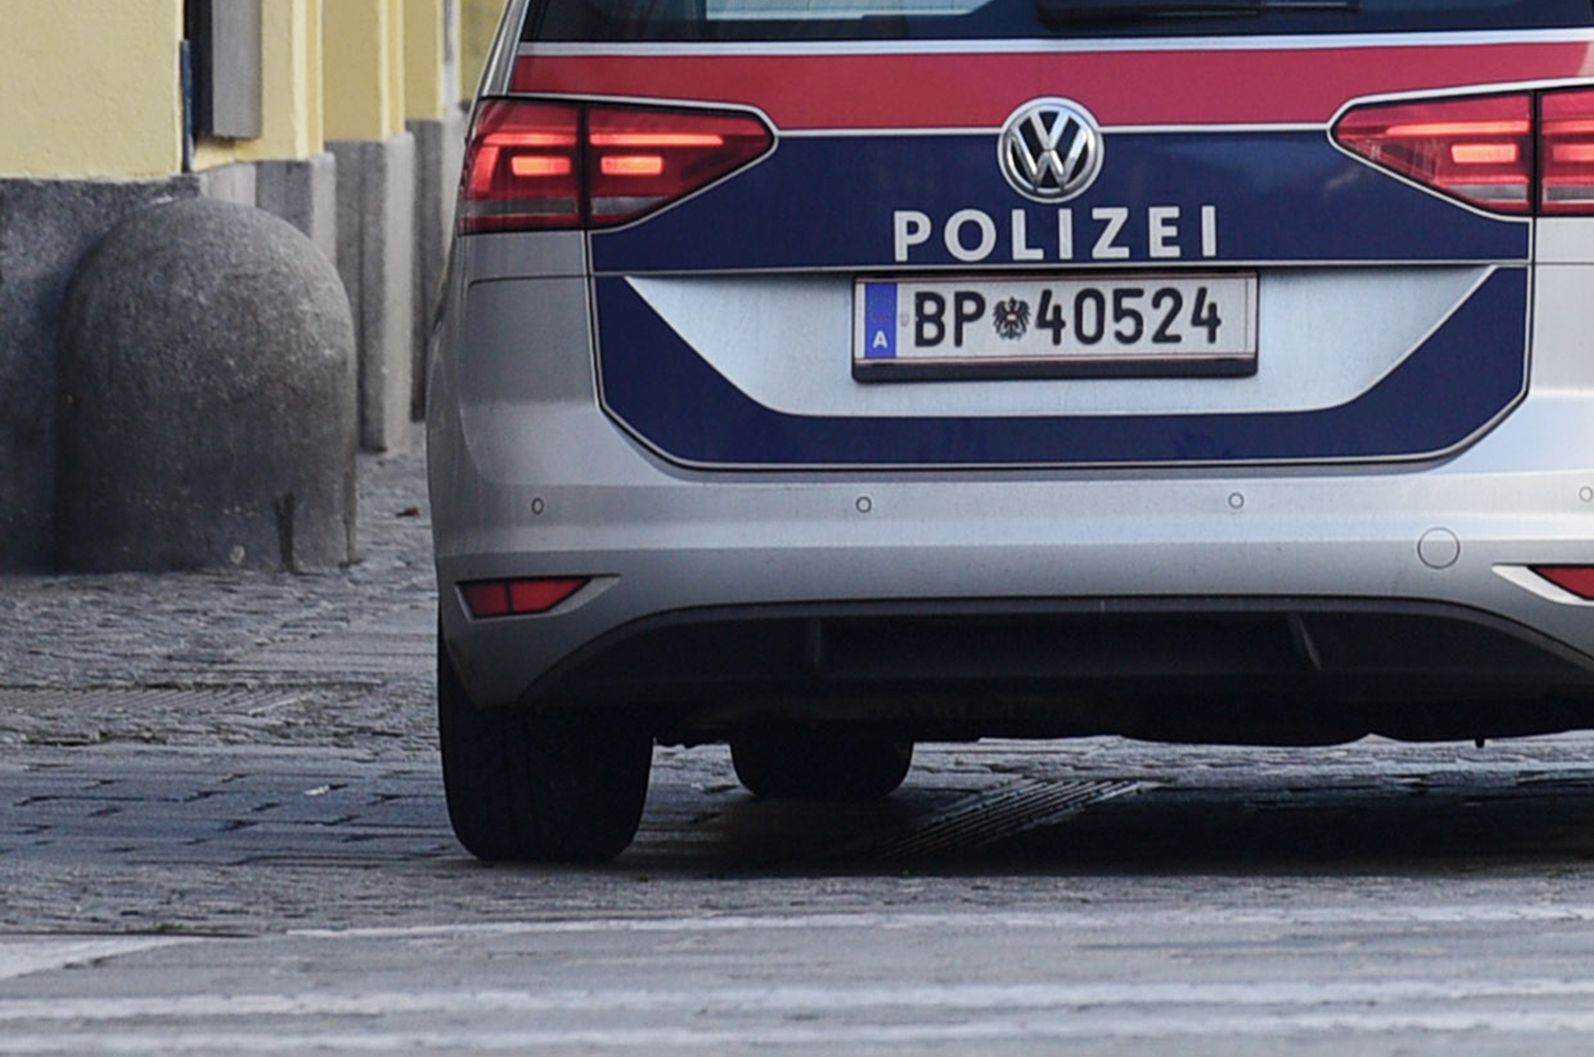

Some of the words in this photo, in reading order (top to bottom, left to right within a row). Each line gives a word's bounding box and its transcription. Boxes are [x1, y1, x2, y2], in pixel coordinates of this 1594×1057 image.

[893, 206, 1217, 262] POLIZEI
[872, 330, 889, 349] A
[914, 290, 987, 348] BP
[1035, 287, 1222, 346] 40524
